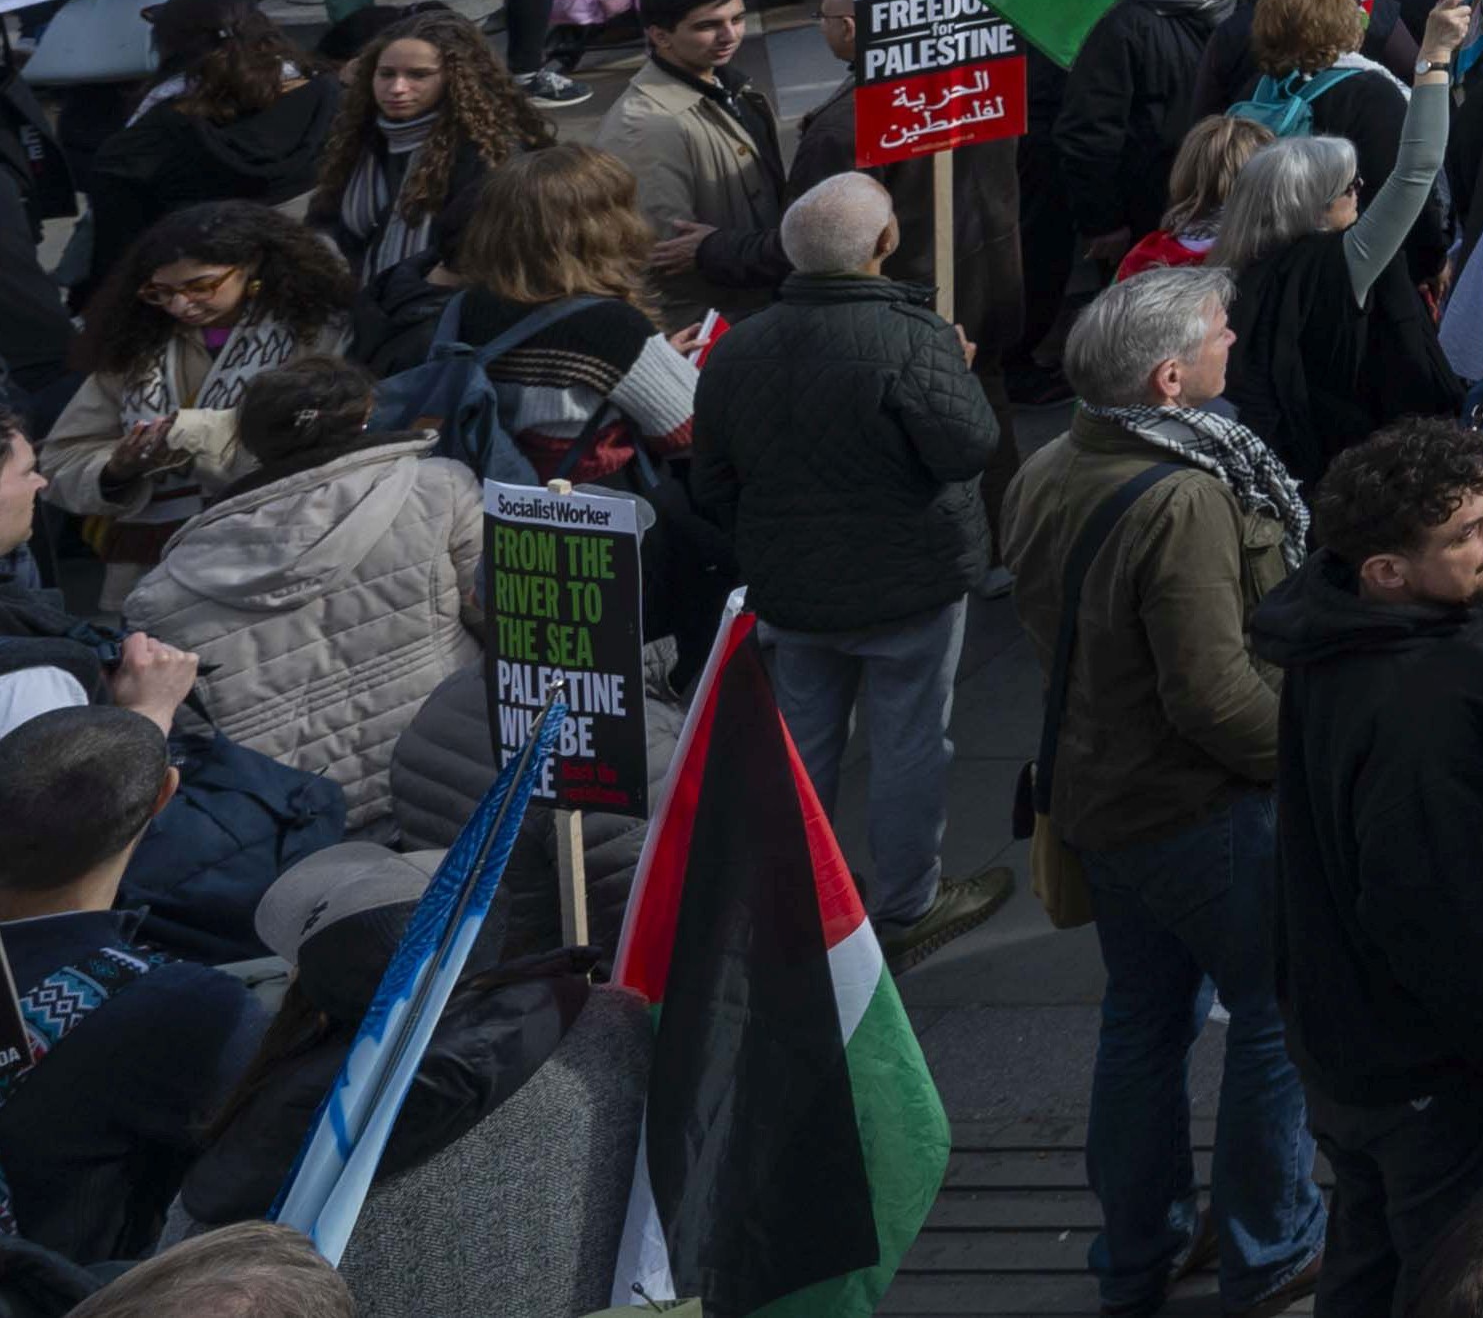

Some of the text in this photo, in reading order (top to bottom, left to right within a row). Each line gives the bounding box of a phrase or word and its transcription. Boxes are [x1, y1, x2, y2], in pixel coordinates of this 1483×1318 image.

[866, 24, 1015, 80] PALESTINE
[930, 19, 954, 35] for
[892, 69, 990, 111] الحرية
[880, 95, 1005, 149] لفلسطين
[494, 525, 614, 579] FROM THE
[495, 569, 602, 623] RIVER TO
[496, 615, 594, 667] THE SEA
[497, 660, 626, 715] PALESTINE
[560, 717, 596, 757] BE
